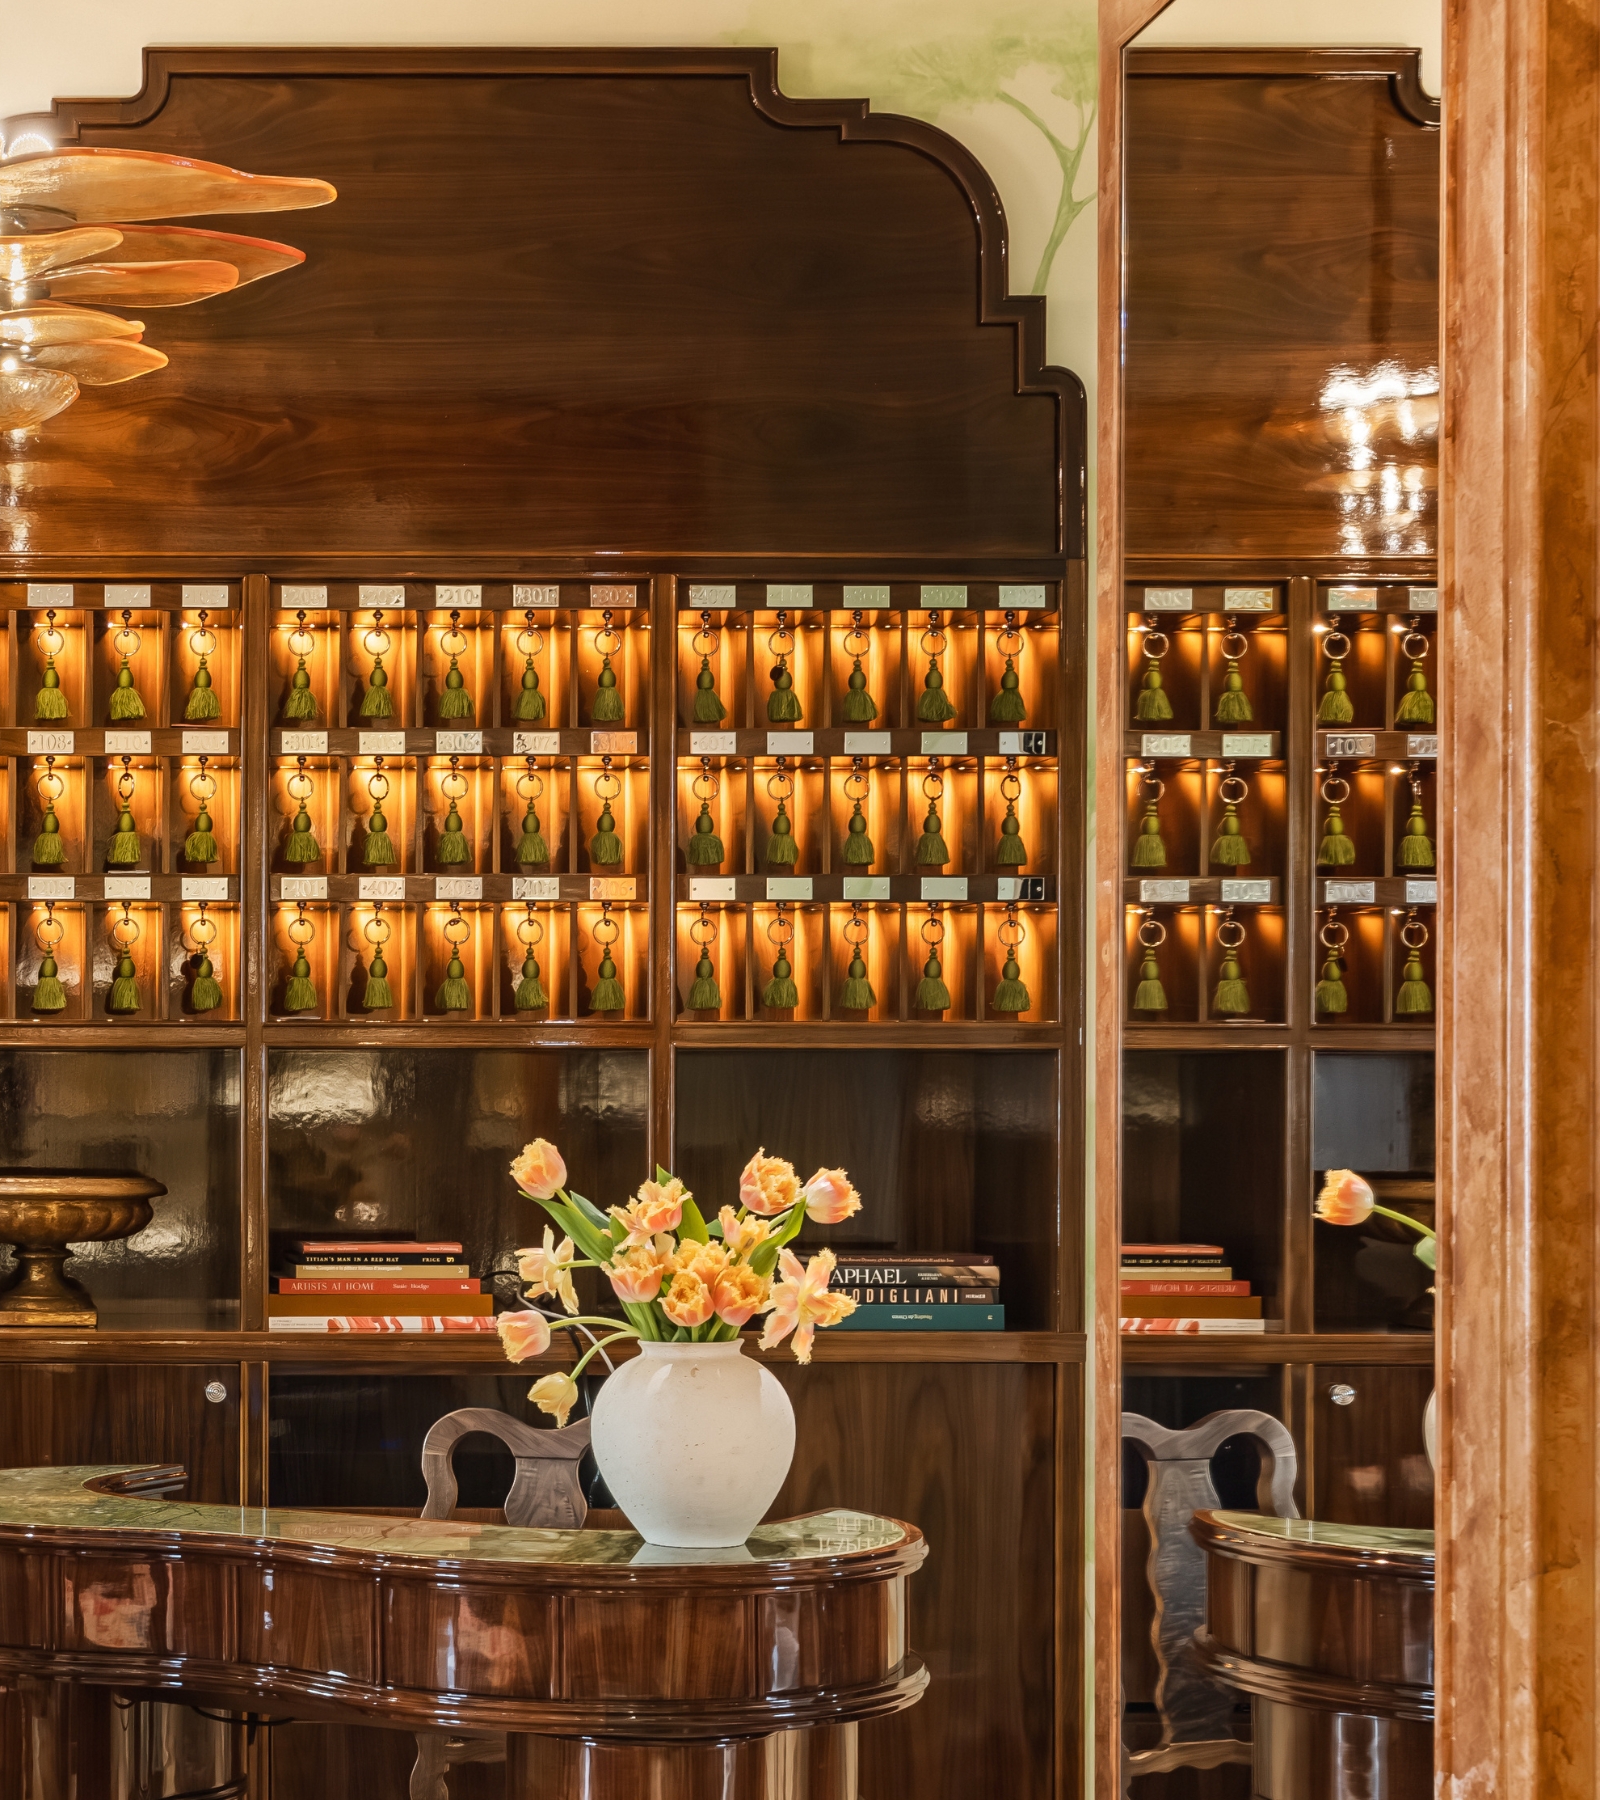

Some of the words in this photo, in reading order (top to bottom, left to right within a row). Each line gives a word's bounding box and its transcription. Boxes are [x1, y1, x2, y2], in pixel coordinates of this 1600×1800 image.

[443, 588, 473, 605] 210
[522, 587, 551, 604] 301
[599, 588, 629, 604] 302
[698, 588, 728, 605] 407
[37, 734, 67, 750] 108
[113, 735, 143, 750] 110
[191, 735, 220, 750] 201
[289, 734, 319, 750] 303
[443, 734, 475, 751] 306
[699, 735, 728, 751] 601
[38, 880, 67, 896] 205
[190, 881, 220, 896] 207
[289, 880, 319, 896] 401
[367, 880, 398, 896] 402
[599, 880, 629, 896] 406
[830, 1268, 907, 1284] APHAEL
[291, 1282, 328, 1291] ARTISTS
[332, 1282, 342, 1291] AT
[346, 1282, 375, 1291] HOME
